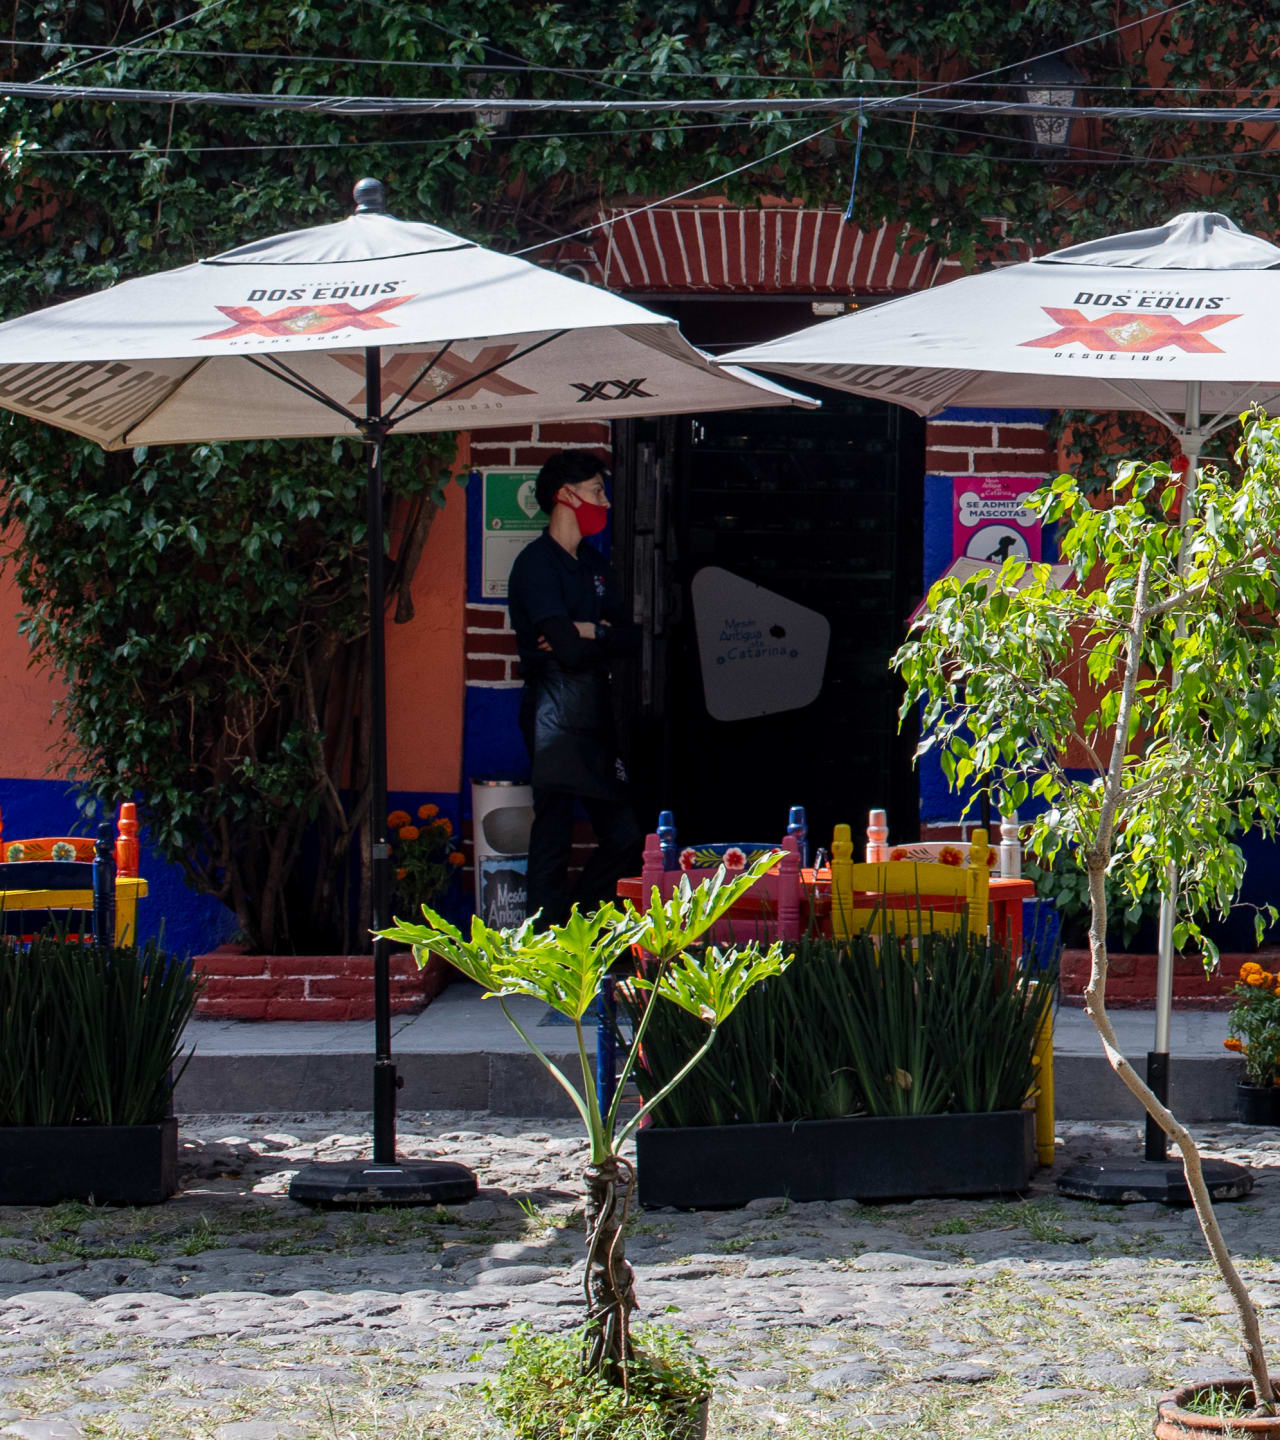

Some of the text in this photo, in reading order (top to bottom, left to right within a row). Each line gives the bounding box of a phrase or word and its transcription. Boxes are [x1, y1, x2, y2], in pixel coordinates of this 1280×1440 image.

[247, 280, 400, 302] DOS EQUIS
[1073, 292, 1227, 310] DOS EQUIS
[1054, 351, 1117, 361] DESDE
[965, 501, 1023, 509] SE ADMITE
[969, 510, 1027, 518] MASCOTAS
[728, 647, 787, 660] Catarina
